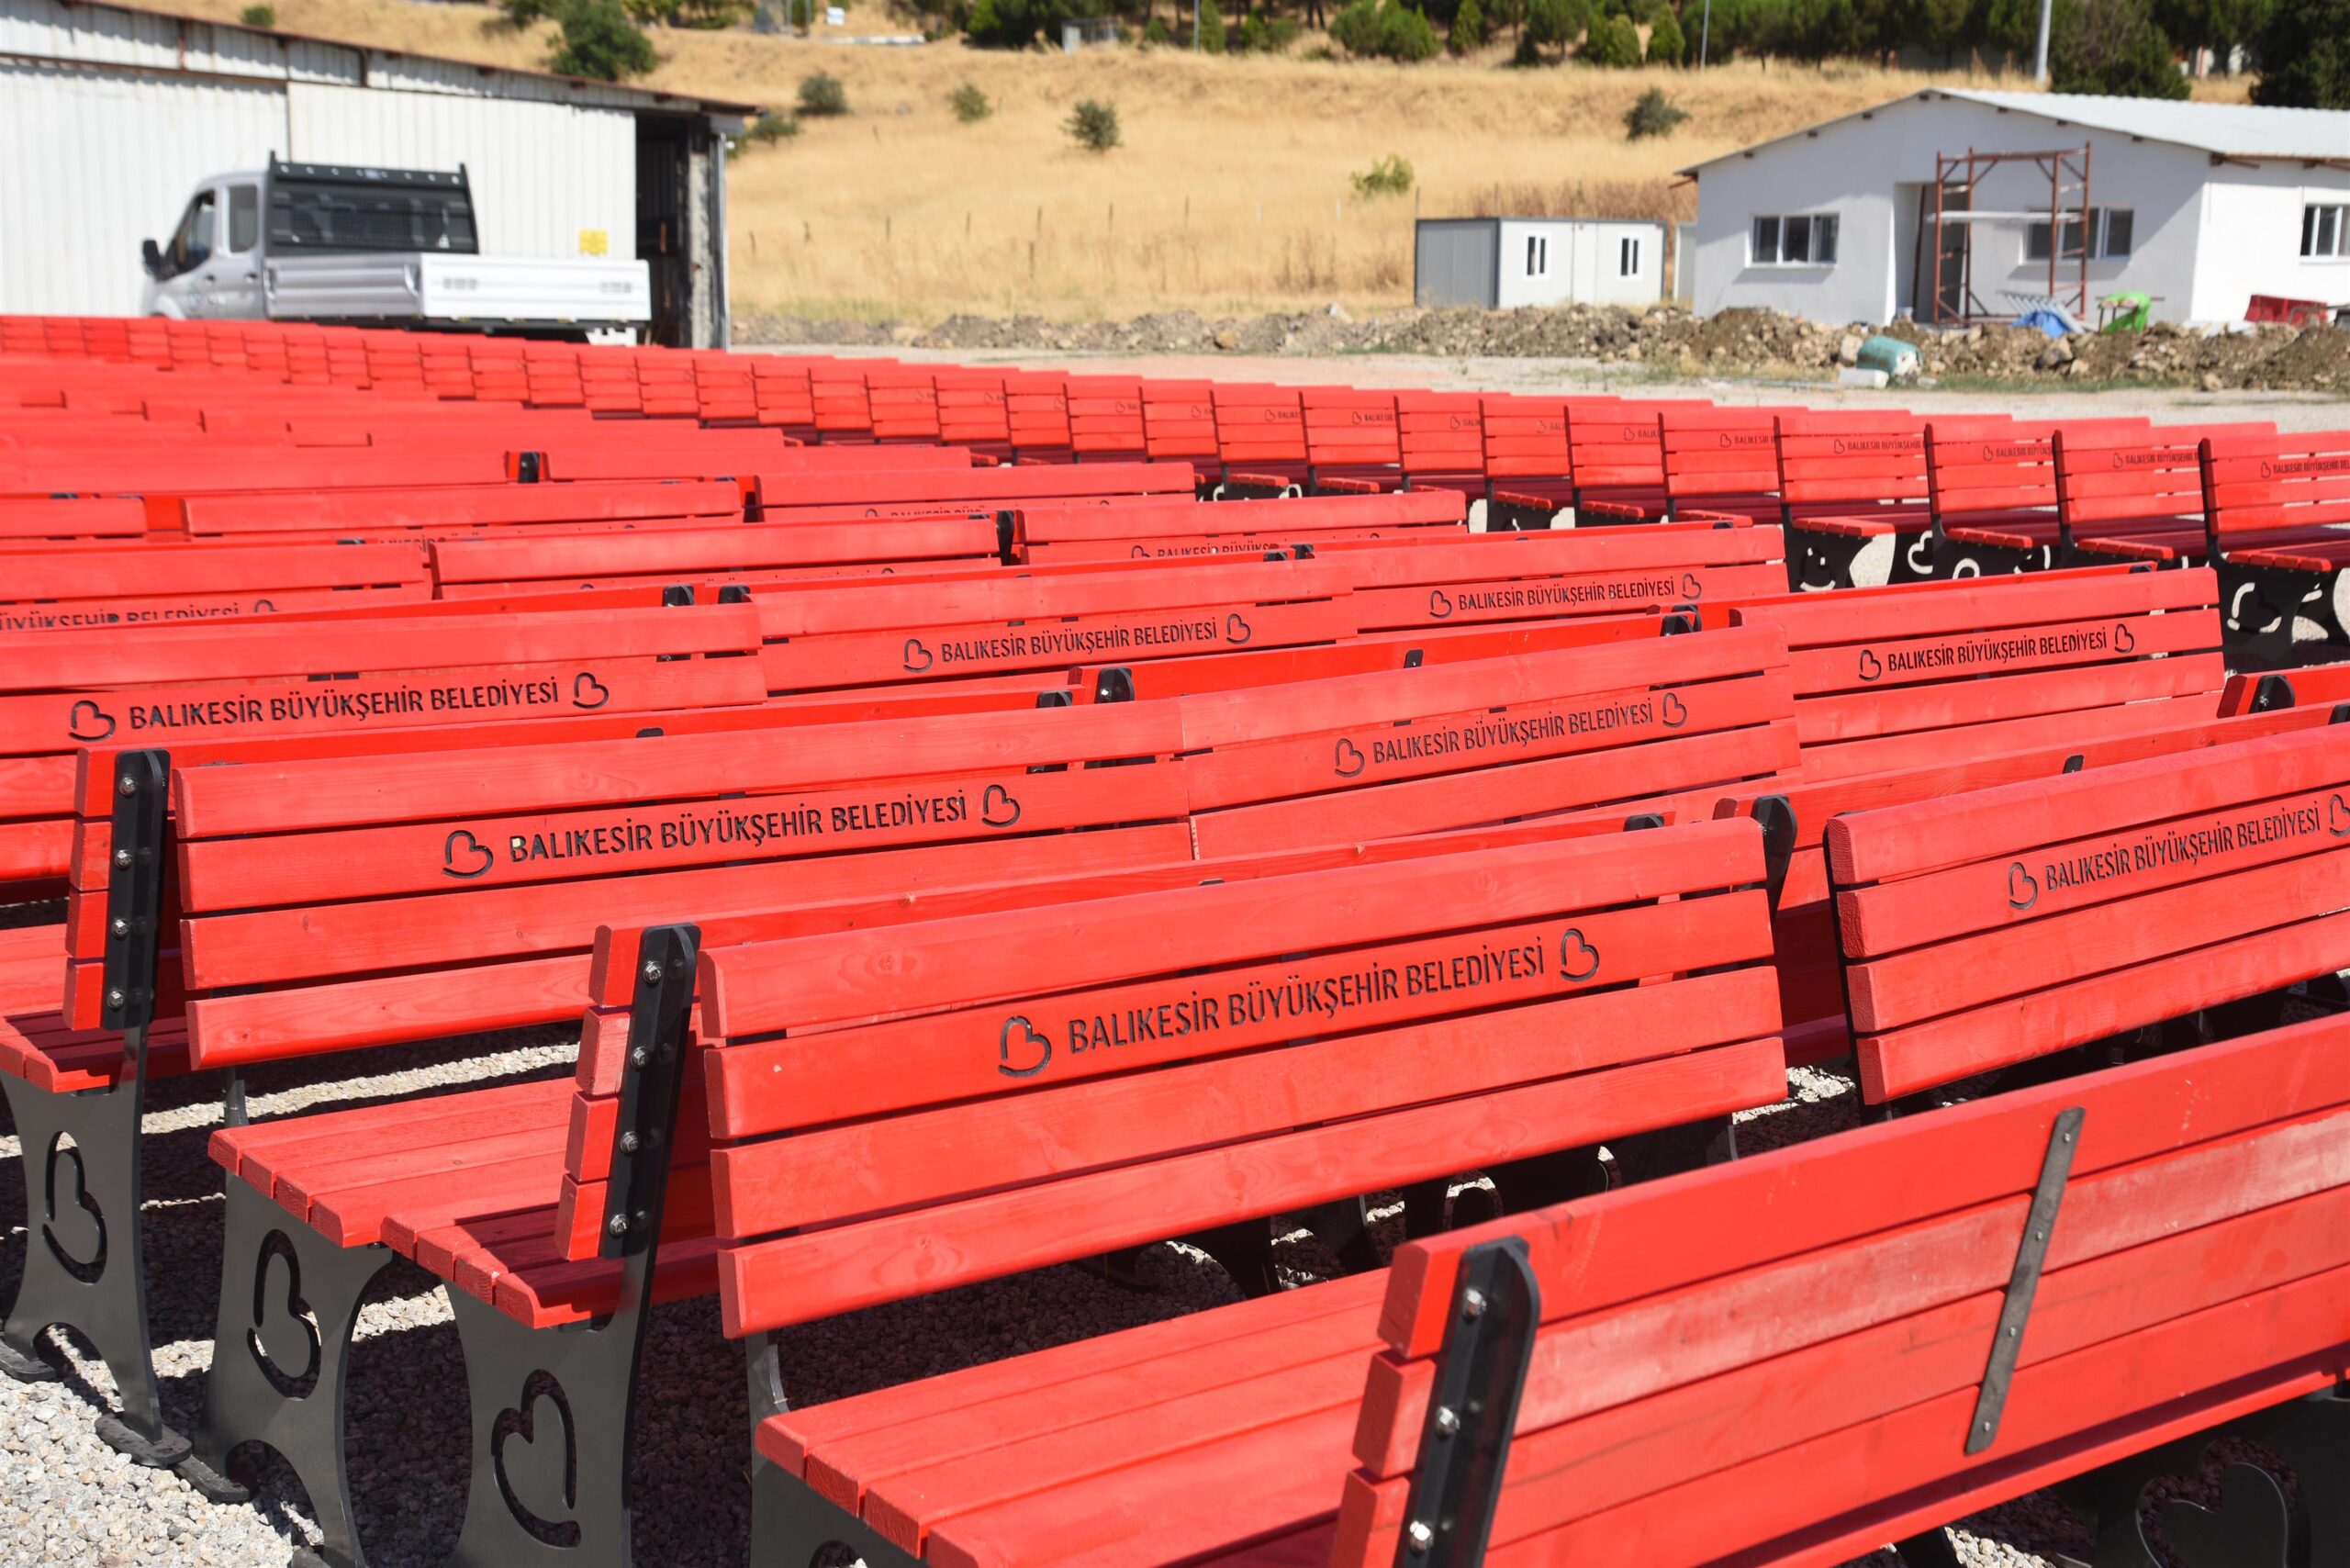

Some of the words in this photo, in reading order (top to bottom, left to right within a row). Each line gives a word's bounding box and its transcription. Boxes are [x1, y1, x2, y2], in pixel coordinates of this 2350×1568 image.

[1460, 588, 1523, 610] BALIKESİR
[1528, 583, 1605, 605] BÜYÜKŞEHİR
[1609, 577, 1674, 599] BELEDİYESİ
[941, 633, 1025, 662] BALIKESİR
[1030, 625, 1129, 655] BÜYÜKŞEHİR
[1134, 617, 1216, 645] BELEDİYESİ
[1888, 644, 1953, 671] BALIKESİR
[1958, 635, 2036, 663] BÜYÜKŞEHİR
[2040, 628, 2106, 654] BELEDİYESİ
[130, 695, 263, 729] BALIKESİR
[271, 686, 423, 721] BÜYÜKŞEHİR
[431, 677, 558, 710] BELEDİYESİ
[1373, 728, 1460, 763] BALIKESİR
[1464, 711, 1564, 748] BÜYÜKŞEHİR
[1569, 699, 1652, 734] BELEDİYESİ
[509, 819, 653, 862] BALIKESİR
[661, 803, 822, 848] BÜYÜKŞEHİR
[832, 790, 966, 832] BELEDİYESİ
[2045, 843, 2132, 890] BALIKESİR
[2134, 822, 2234, 871] BÜYÜKŞEHİR
[2237, 801, 2321, 848] BELEDİYESİ
[1069, 991, 1219, 1053] BALIKESİR
[1228, 962, 1398, 1025] BÜYÜKŞEHİR
[1406, 936, 1543, 996] BELEDİYESİ
